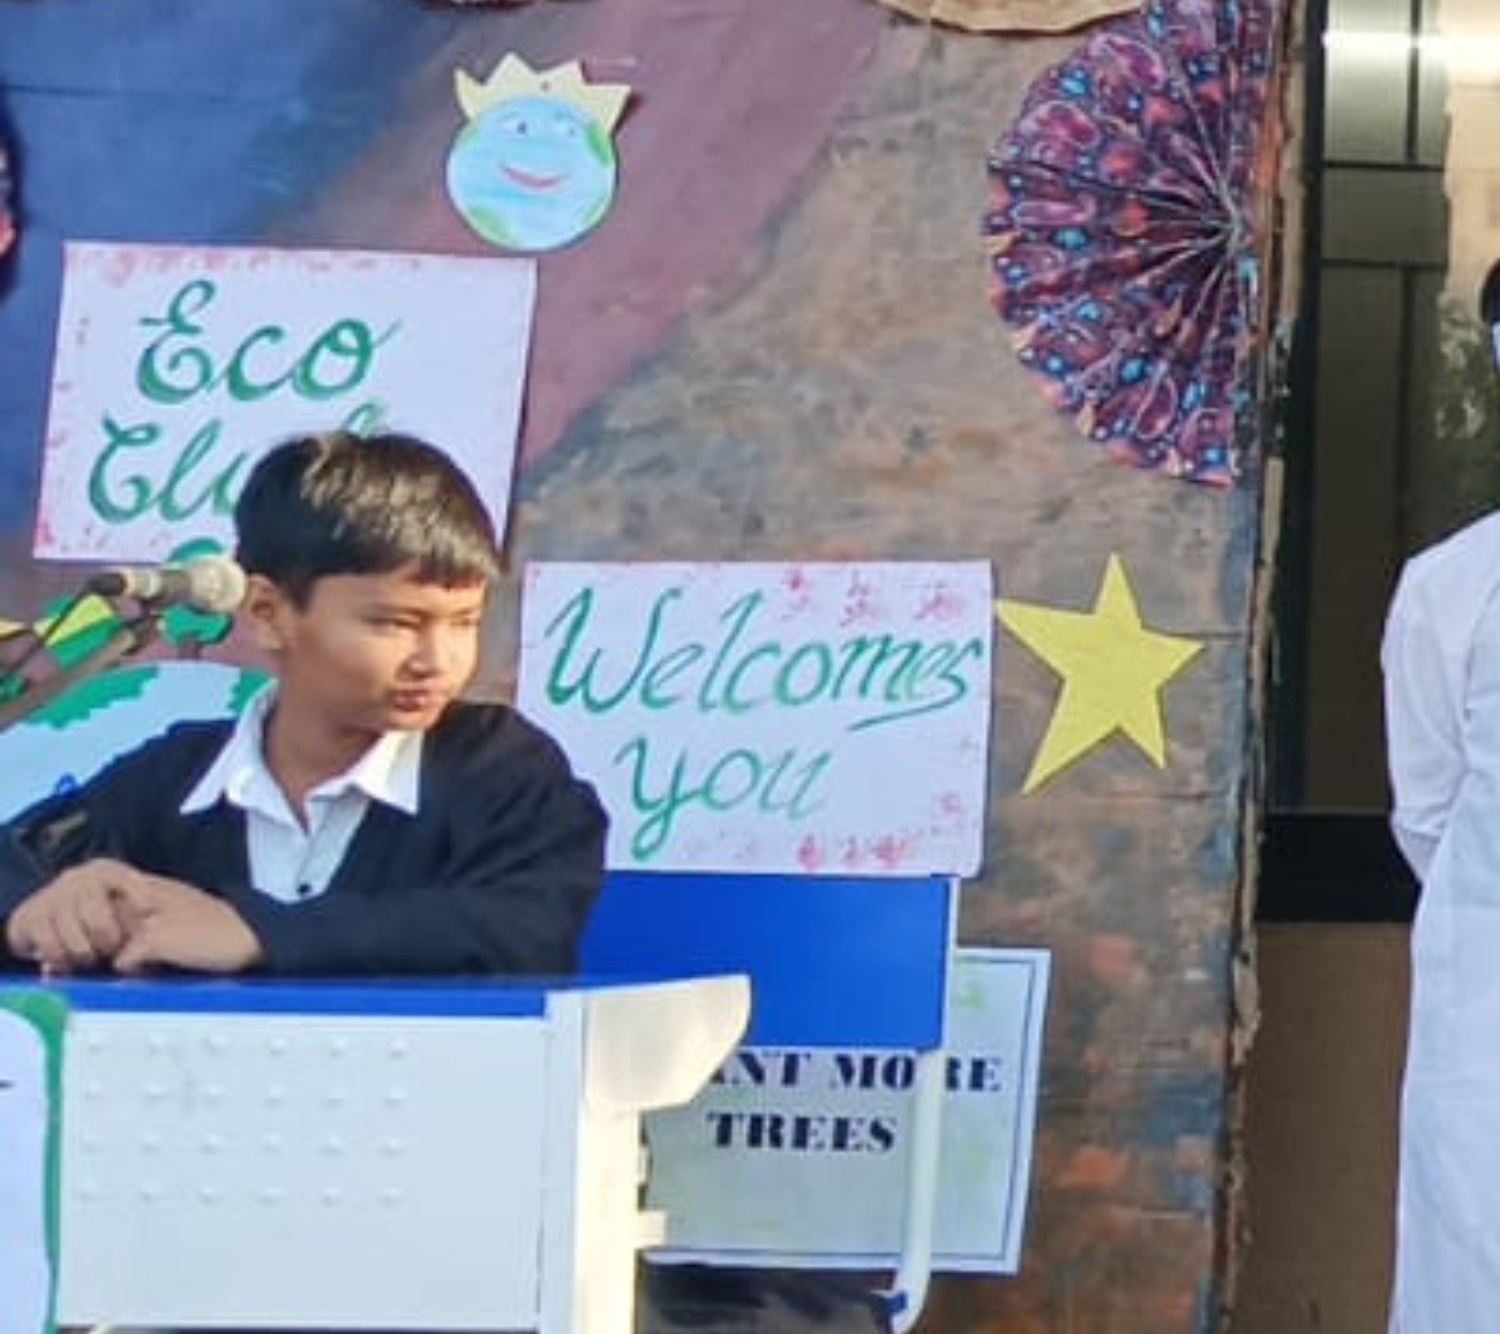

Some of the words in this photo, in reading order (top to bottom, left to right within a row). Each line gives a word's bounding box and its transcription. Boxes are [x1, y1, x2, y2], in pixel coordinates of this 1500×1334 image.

[136, 278, 401, 405] Eco
[614, 734, 832, 862] you
[705, 1112, 898, 1152] TREES
